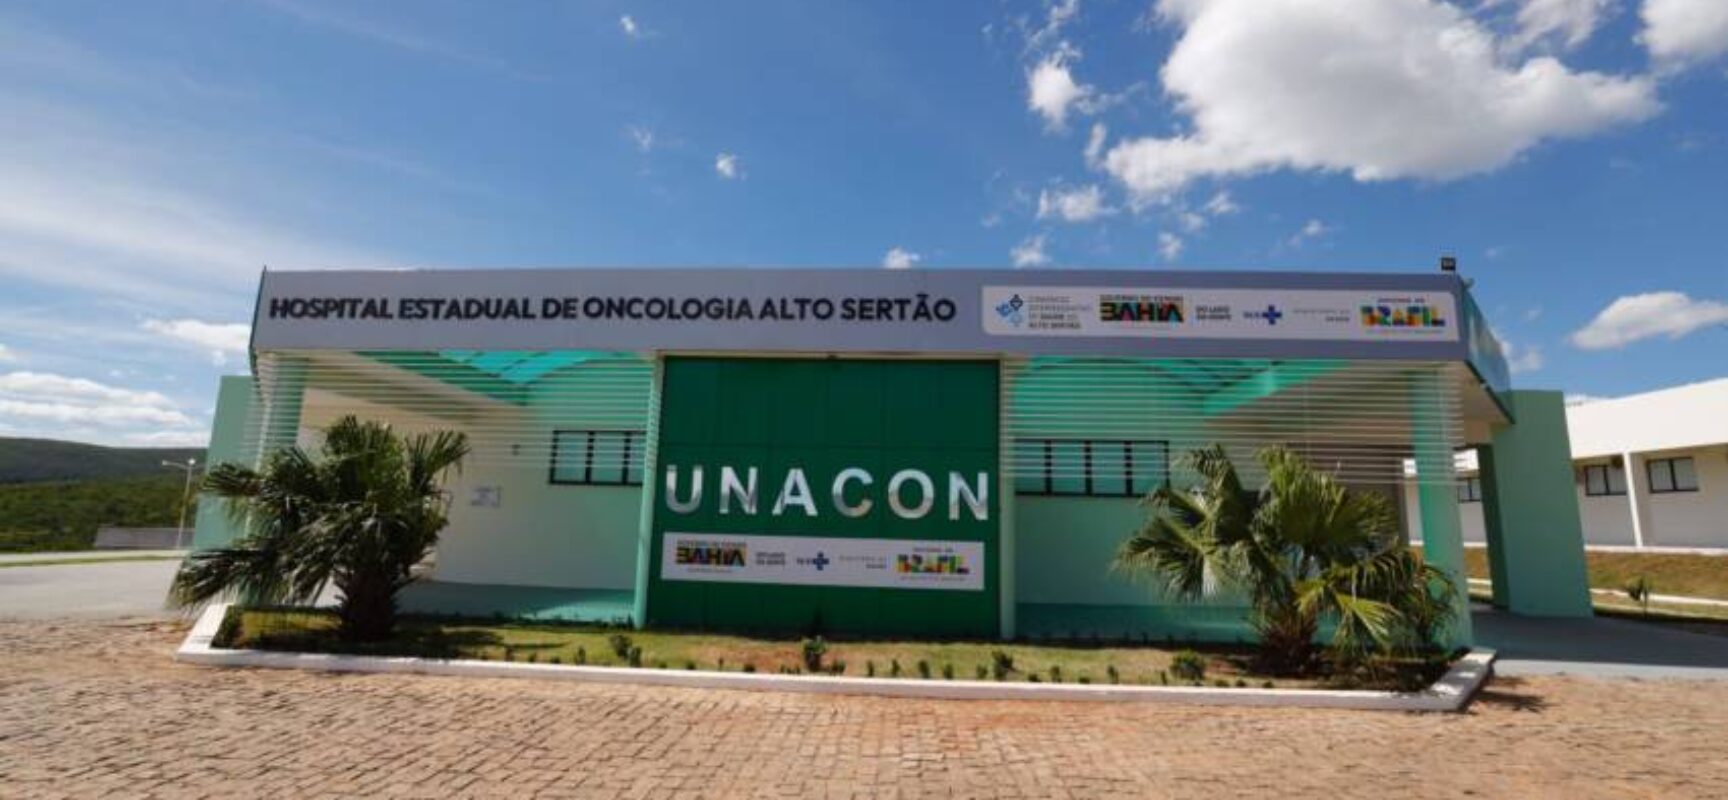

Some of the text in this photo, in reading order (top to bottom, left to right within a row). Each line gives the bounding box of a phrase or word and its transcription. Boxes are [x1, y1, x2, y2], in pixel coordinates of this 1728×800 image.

[269, 292, 957, 322] HOSPITAL ESTADUAL DE ONCOLOGIA ALTO SERTÃO
[1100, 301, 1184, 323] BAHIA
[1361, 306, 1446, 327] BRASIL
[666, 464, 989, 521] UNACON
[677, 546, 746, 567] BAHIA
